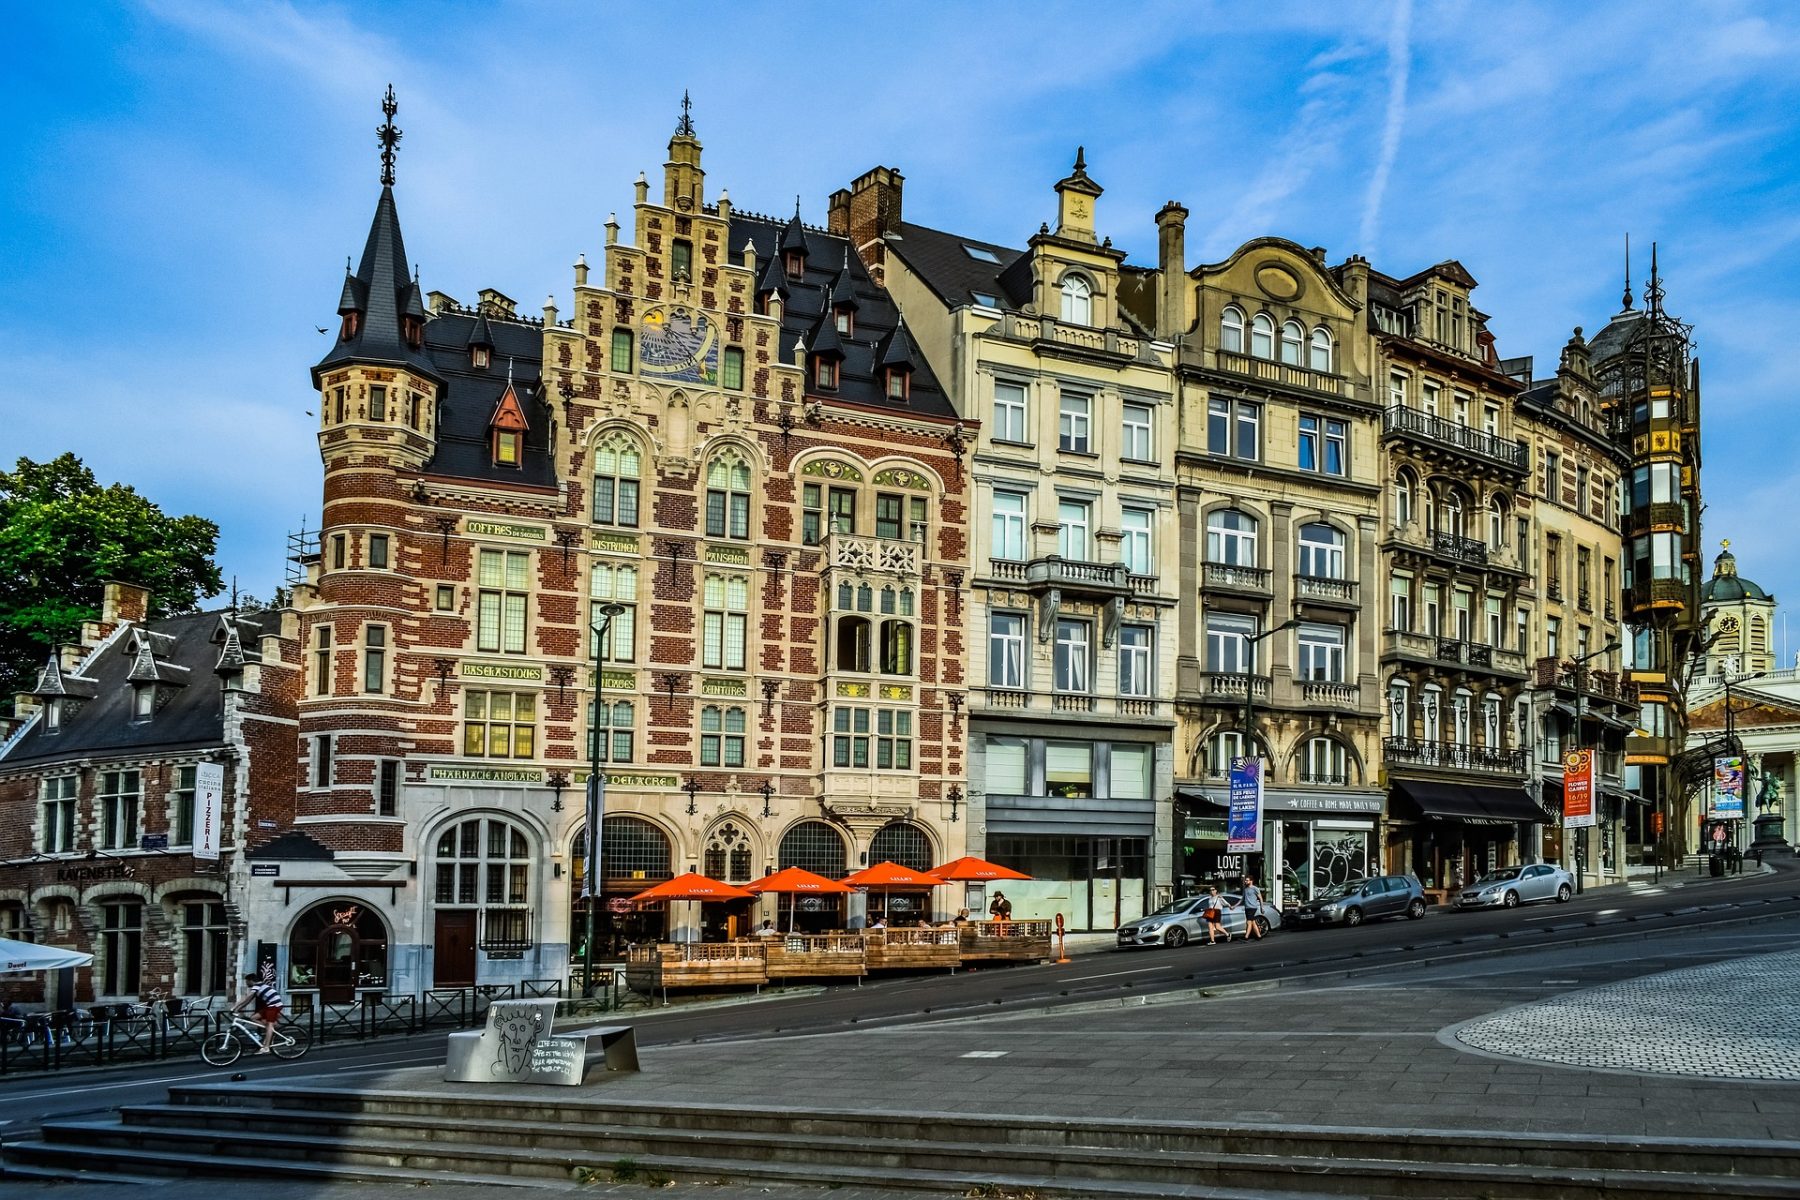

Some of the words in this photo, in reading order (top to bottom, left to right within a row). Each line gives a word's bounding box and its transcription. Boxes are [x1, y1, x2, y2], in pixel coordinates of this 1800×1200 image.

[468, 522, 512, 536] COFFRES
[589, 678, 635, 689] BNDAGES
[433, 770, 491, 780] PHARMACIE
[493, 772, 541, 782] ANGLAISE
[611, 775, 667, 786] DELACRE
[1300, 799, 1317, 808] COFFEE
[1325, 800, 1337, 809] HOME
[1339, 800, 1352, 810] MADE
[204, 792, 212, 850] PIZZERIA
[1217, 855, 1241, 869] LOVE
[58, 866, 134, 881] RAVENSTE
